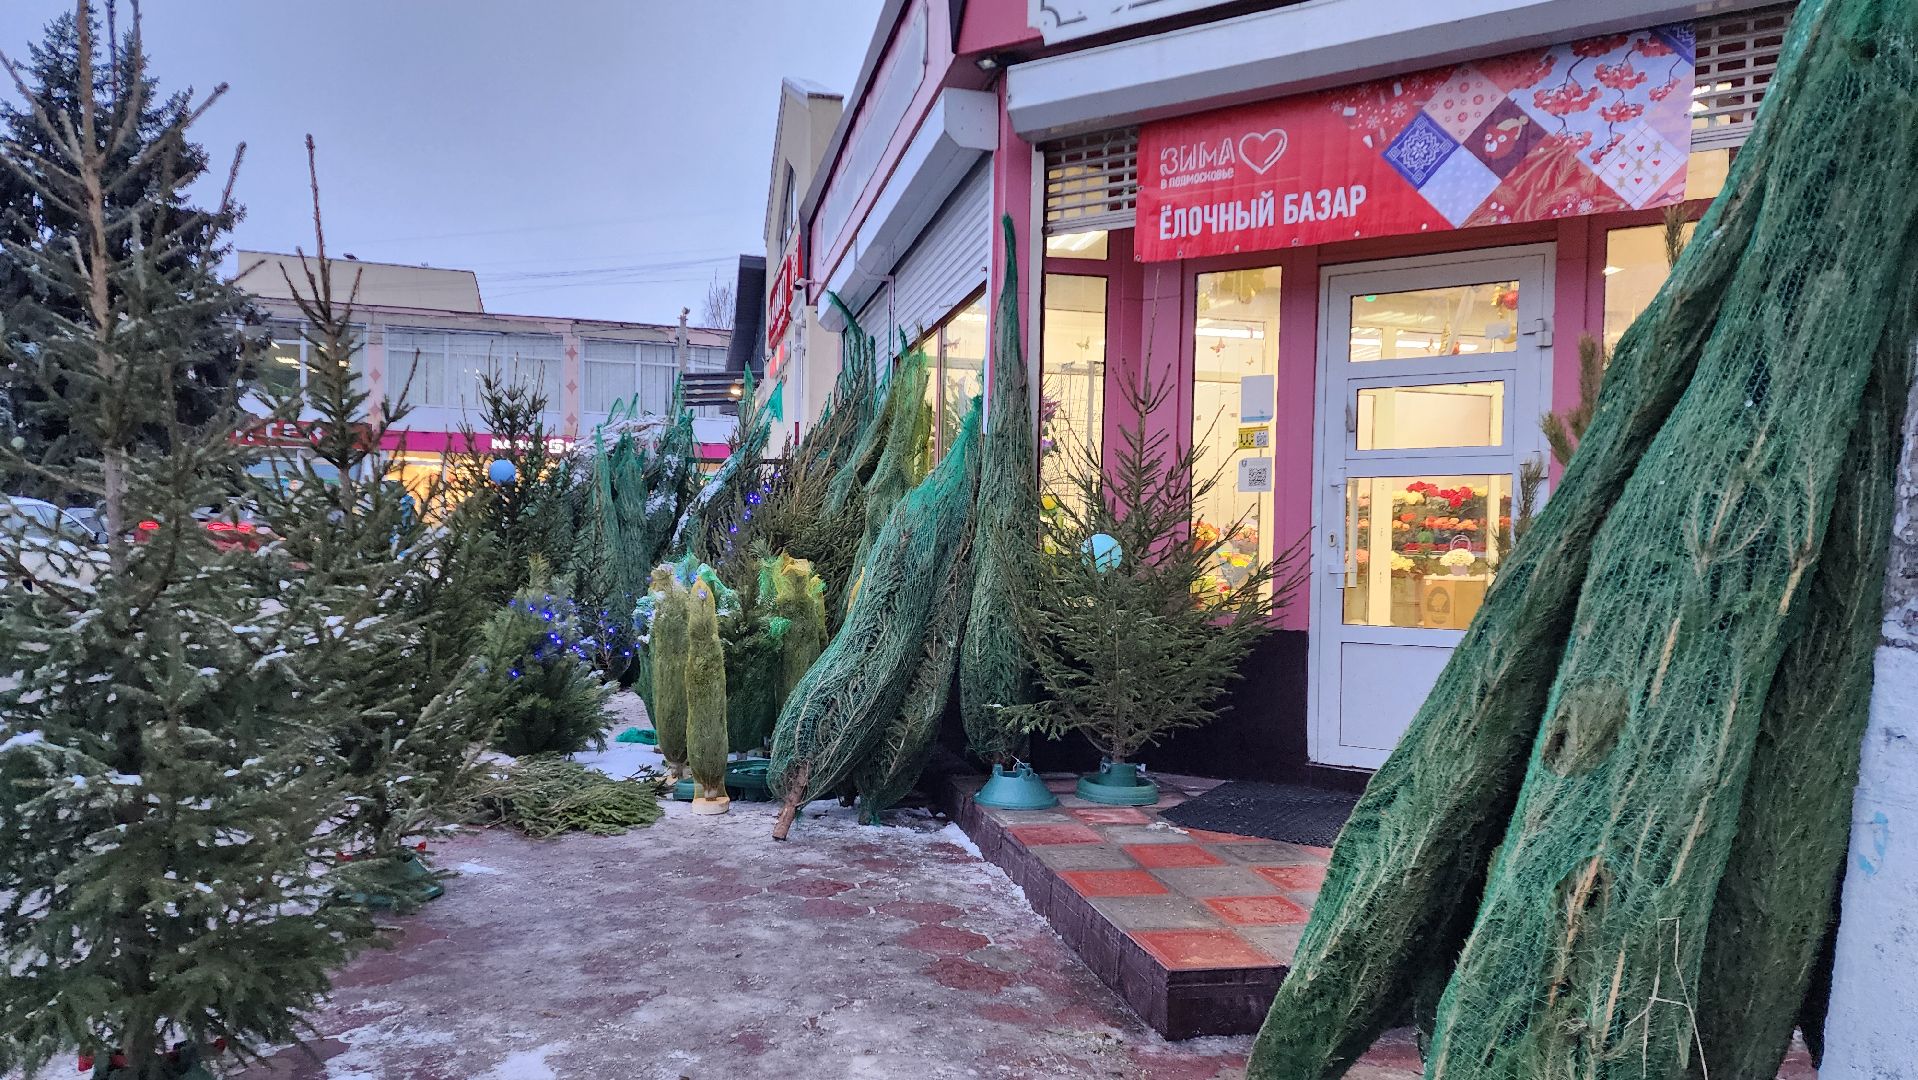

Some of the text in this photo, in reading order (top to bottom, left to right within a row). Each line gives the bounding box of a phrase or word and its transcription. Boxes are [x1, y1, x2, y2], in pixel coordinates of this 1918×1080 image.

[1160, 137, 1235, 176] ЗИМА
[1159, 184, 1367, 241] ЁЛОЧНЫЙ БАЗАР
